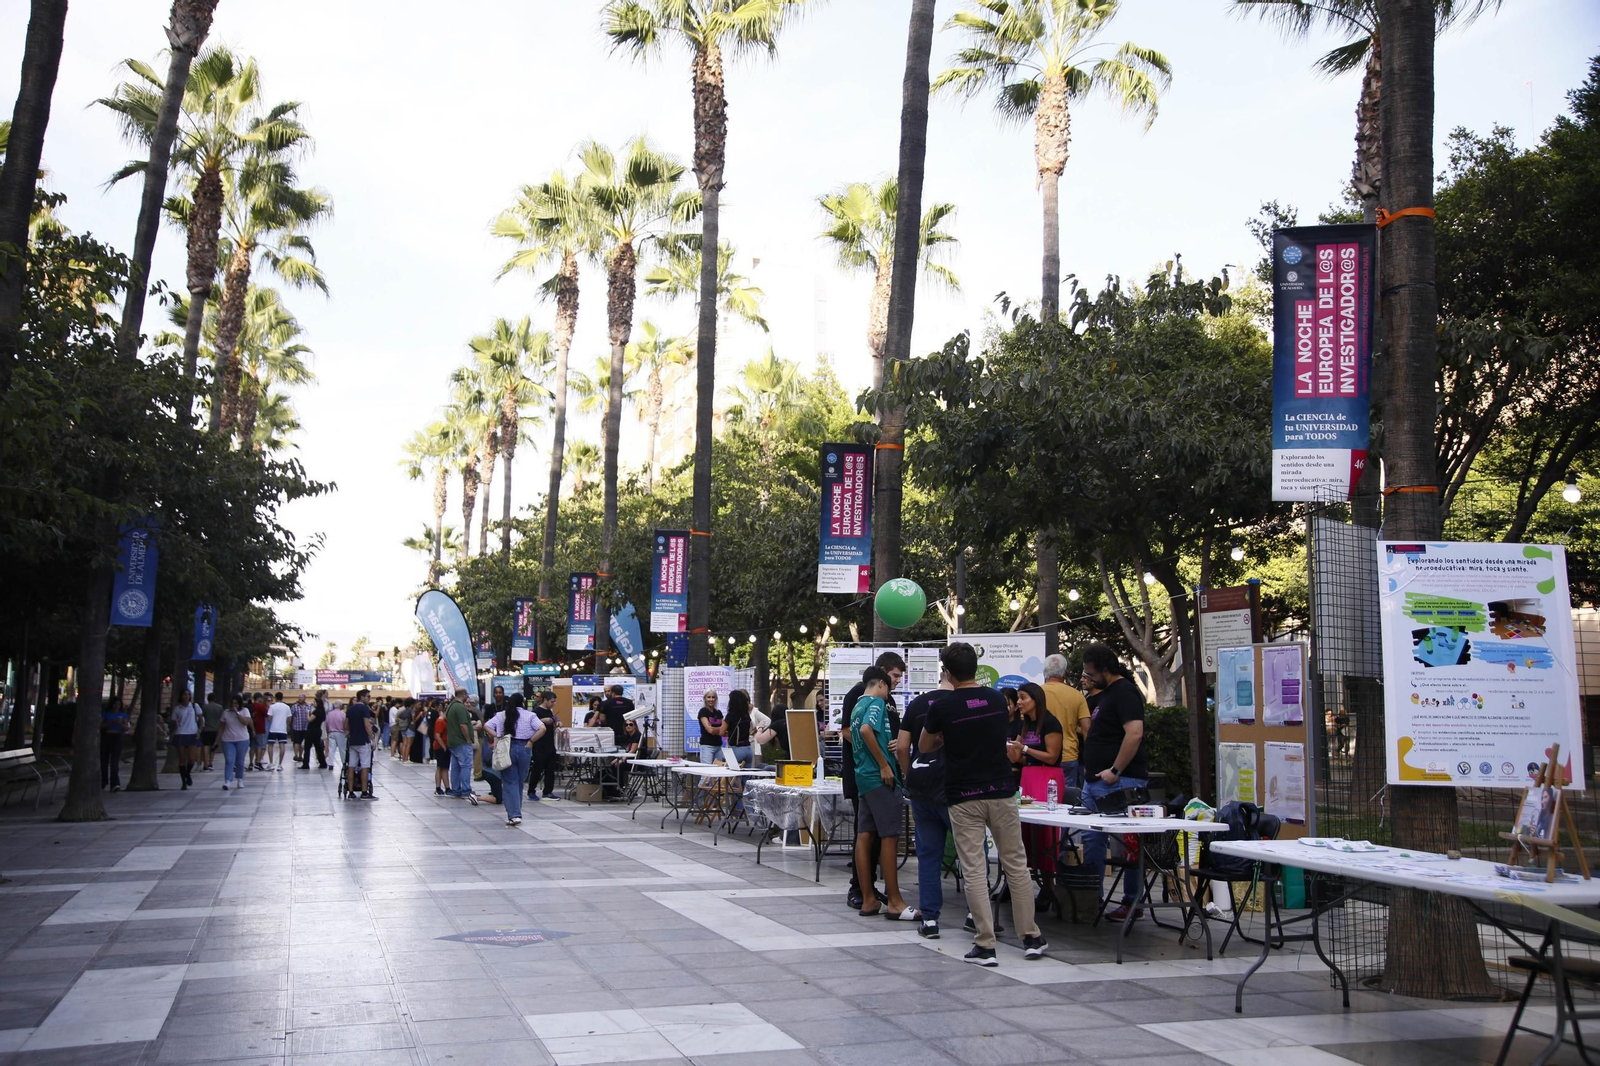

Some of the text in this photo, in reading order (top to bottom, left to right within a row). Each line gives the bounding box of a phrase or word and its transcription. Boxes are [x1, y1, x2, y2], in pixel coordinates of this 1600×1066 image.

[1298, 304, 1312, 394] LA NOCHE
[1319, 248, 1334, 393] EUROPEA DE L@S
[1340, 248, 1355, 393] INVESTIGADOR@S
[843, 455, 854, 535] EUROPEA DE L@S
[854, 456, 864, 536] INVESTIGADOR@S
[1354, 460, 1364, 469] 46
[832, 486, 842, 535] LA NOCHE
[135, 573, 144, 584] DE
[661, 583, 666, 592] LA
[1407, 557, 1443, 566] Explorando
